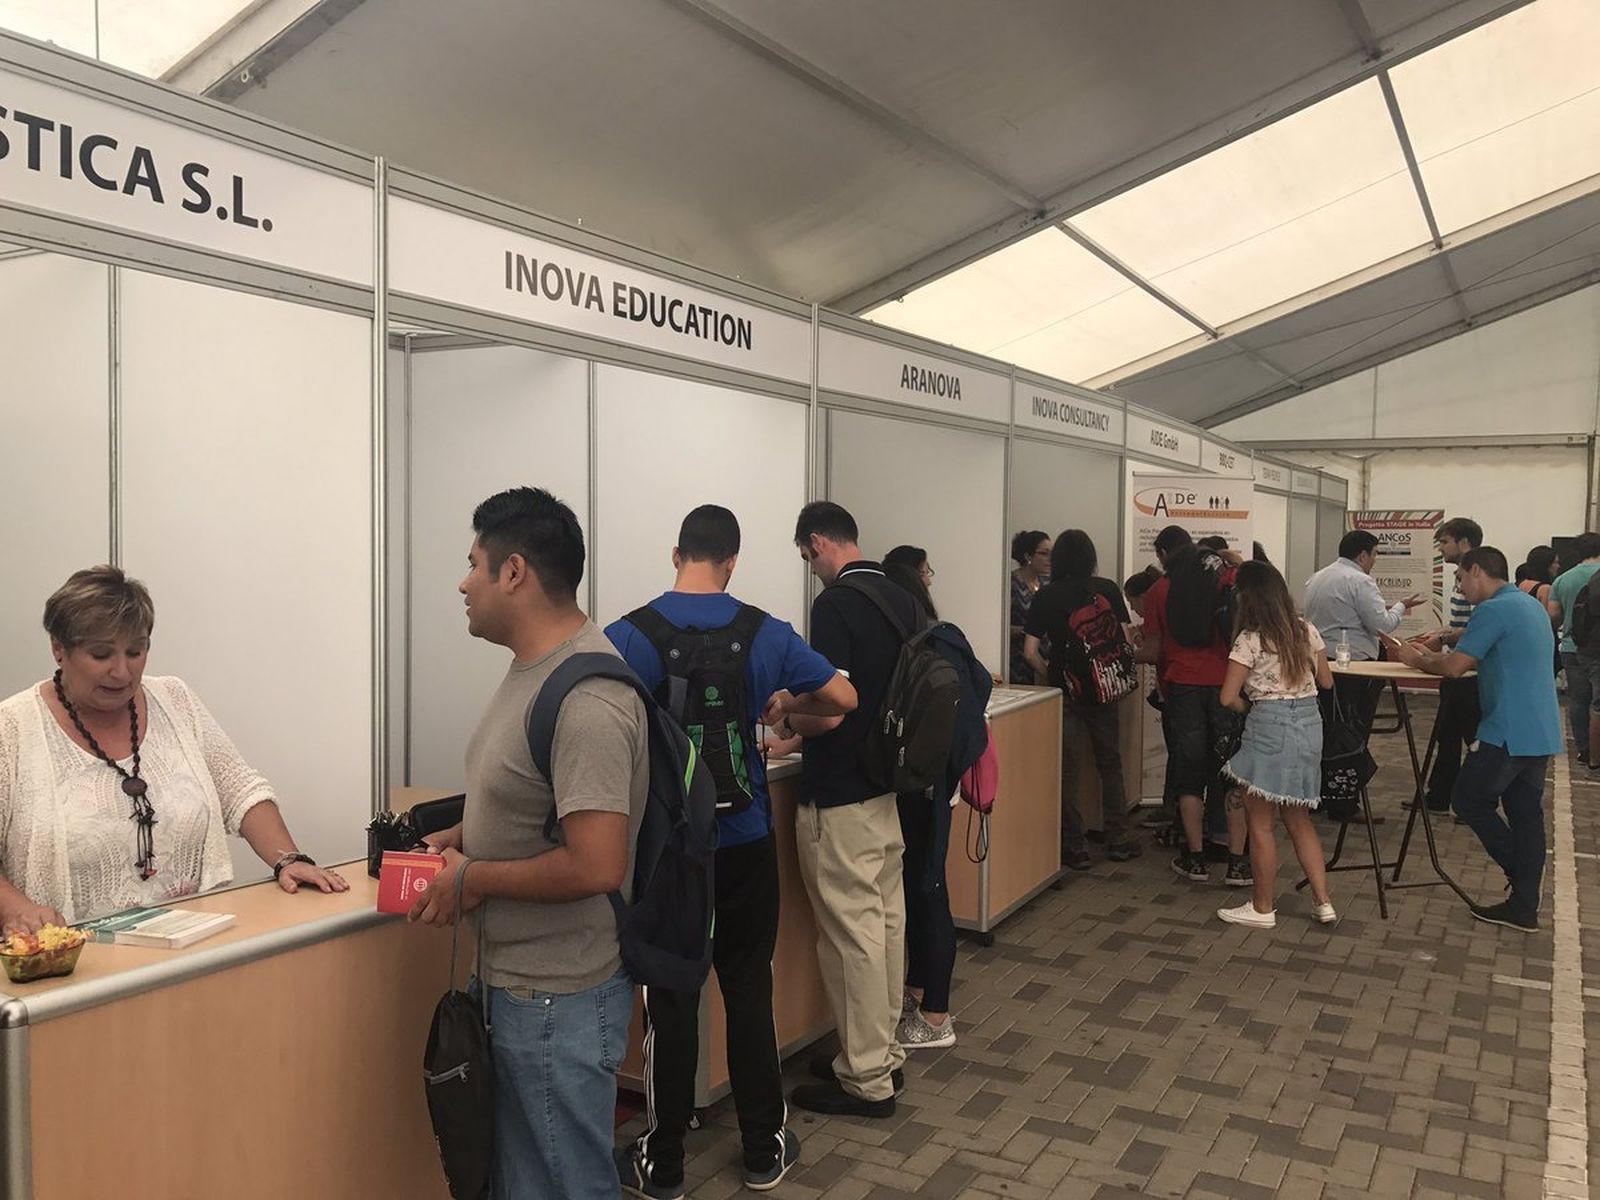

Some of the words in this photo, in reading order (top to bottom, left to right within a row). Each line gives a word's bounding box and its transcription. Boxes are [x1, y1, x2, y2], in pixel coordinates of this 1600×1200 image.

[181, 162, 273, 232] S.L.
[504, 250, 605, 313] INOVA
[612, 281, 752, 350] EDUCATION
[900, 364, 962, 401] ARANOVA
[1032, 396, 1059, 421] INOVA
[1059, 403, 1110, 432] CONSULTANCY
